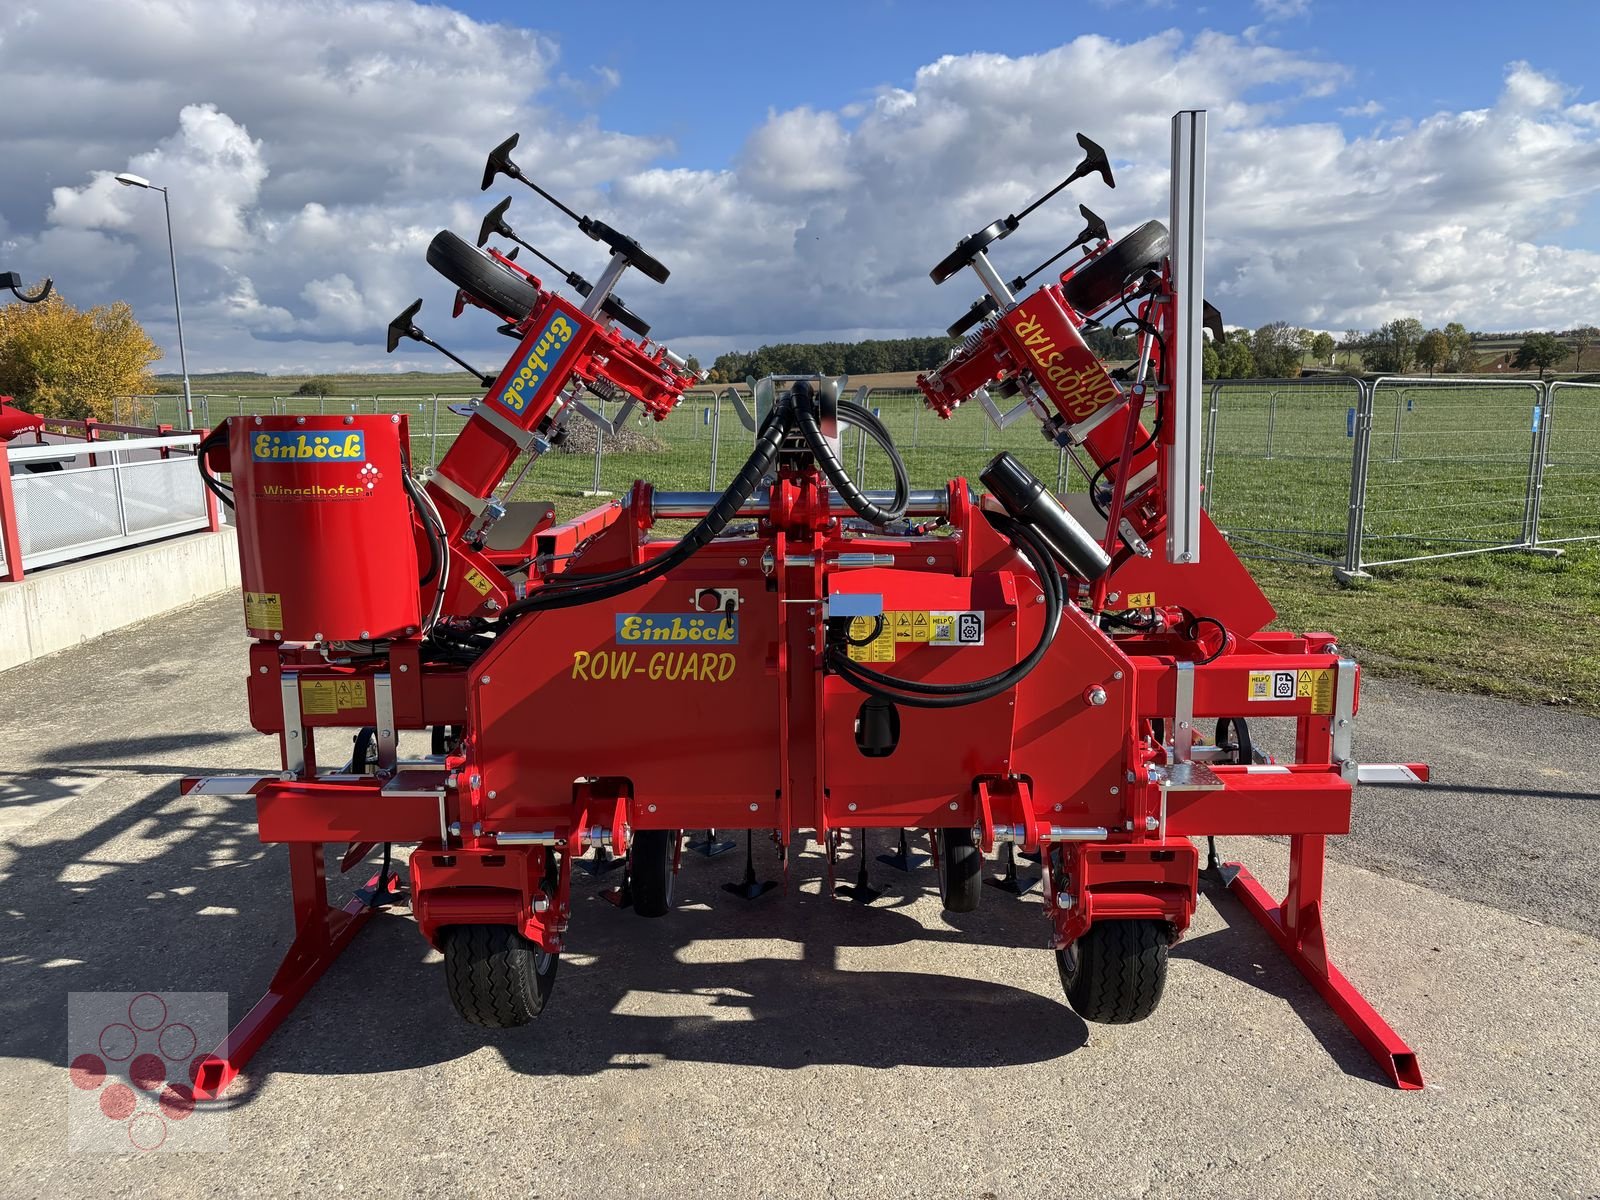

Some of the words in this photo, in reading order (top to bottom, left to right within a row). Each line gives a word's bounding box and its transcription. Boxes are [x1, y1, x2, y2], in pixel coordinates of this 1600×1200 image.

[503, 317, 572, 410] Einböck
[1075, 361, 1118, 404] ONE
[254, 434, 362, 459] Einböck
[620, 616, 735, 641] Einböck
[571, 650, 736, 683] ROW-GUARD
